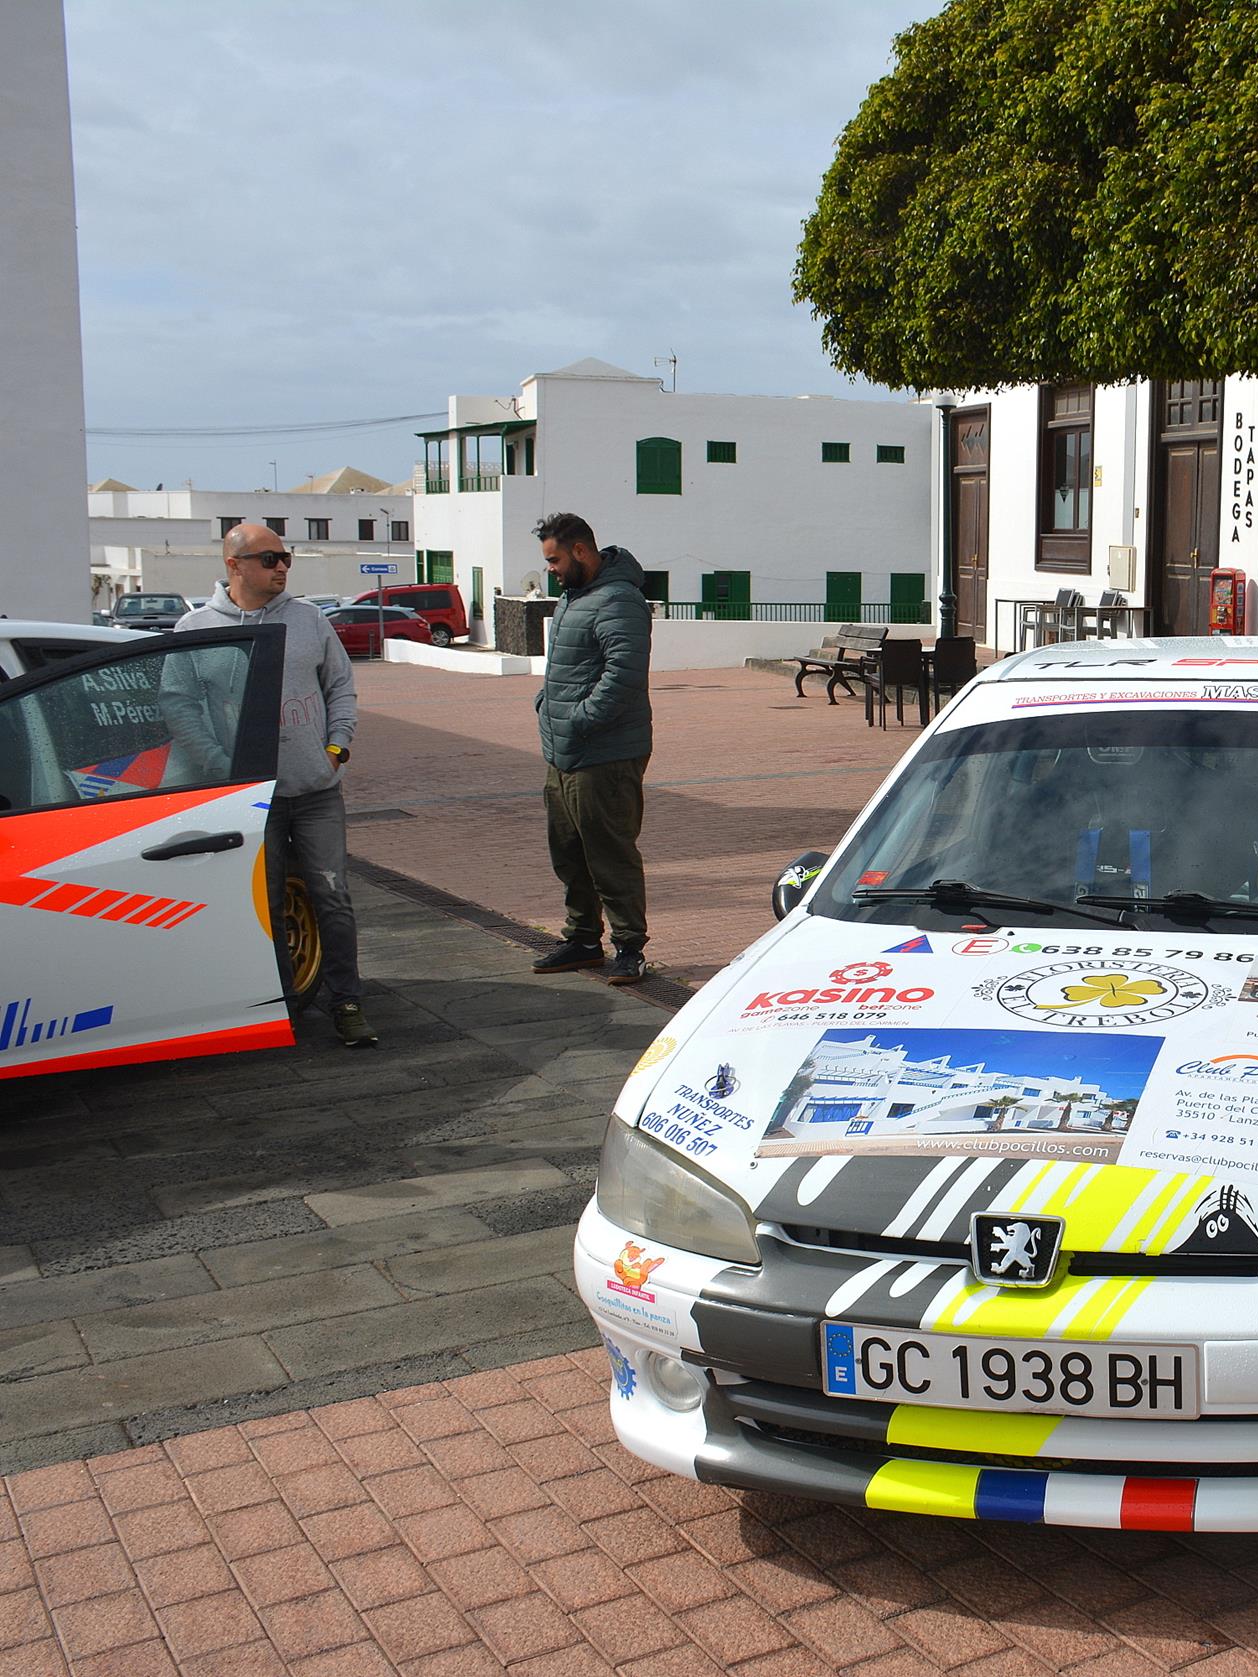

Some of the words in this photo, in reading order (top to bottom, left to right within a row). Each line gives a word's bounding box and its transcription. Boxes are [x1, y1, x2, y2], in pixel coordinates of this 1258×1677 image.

[1231, 412, 1244, 543] BODEGA
[1245, 425, 1256, 528] TAPAS
[1033, 657, 1157, 671] TLR
[81, 665, 151, 693] A.Silva
[1015, 692, 1098, 706] TRANSPORTES
[1099, 692, 1108, 700] Y
[1109, 690, 1199, 700] EXCAVACIONES
[90, 697, 162, 727] M.Pérez
[1041, 944, 1104, 956] 638
[1111, 946, 1153, 958] 85
[1164, 949, 1205, 960] 79
[1212, 951, 1256, 963] 86
[739, 1004, 821, 1019] gamezone
[857, 1003, 923, 1011] betzone
[1001, 996, 1032, 1014] EL
[776, 1012, 811, 1022] 646
[814, 1011, 849, 1021] 518
[852, 1011, 888, 1020] 079
[1174, 1059, 1237, 1076] Club
[1174, 1088, 1193, 1099] Av.
[1198, 1091, 1216, 1101] de
[1219, 1093, 1238, 1104] las
[673, 1084, 756, 1131] TRANSPORTES
[1175, 1098, 1222, 1111] Puerto
[1224, 1103, 1246, 1114] del
[1175, 1108, 1217, 1121] 35510
[666, 1102, 724, 1137] NUÑEZ
[641, 1111, 670, 1133] 606
[663, 1123, 692, 1146] 016
[685, 1136, 719, 1157] 507
[1182, 1131, 1206, 1142] +34
[1210, 1134, 1235, 1145] 928
[1239, 1137, 1254, 1147] 51
[915, 1137, 1111, 1158] www.clubpocillos.com
[834, 1365, 849, 1383] E
[860, 1335, 932, 1395] GC
[951, 1345, 1095, 1406] 1938
[1107, 1352, 1183, 1410] BH
